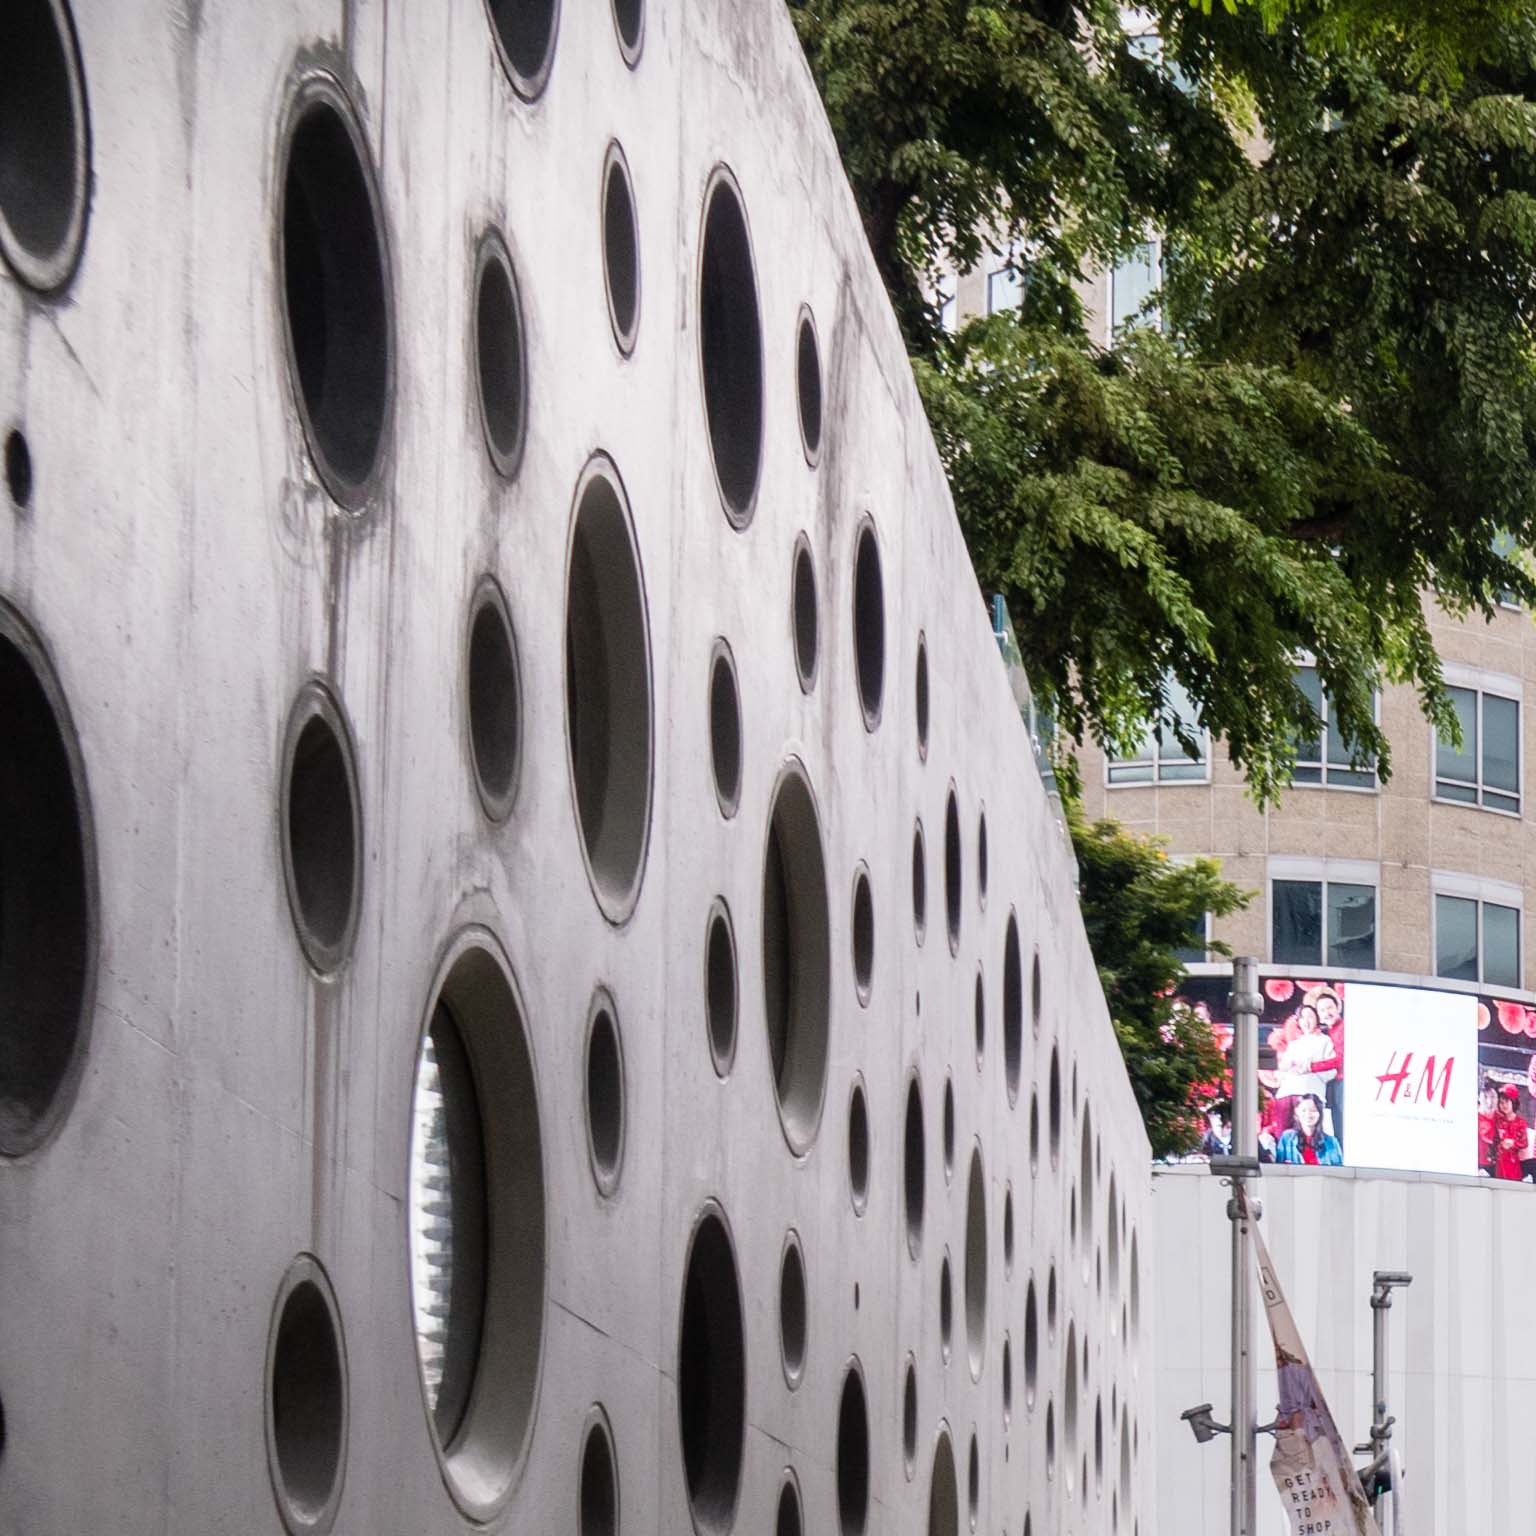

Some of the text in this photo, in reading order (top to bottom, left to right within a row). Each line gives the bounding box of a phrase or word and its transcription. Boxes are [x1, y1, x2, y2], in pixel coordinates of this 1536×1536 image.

[1374, 1051, 1454, 1109] H&M
[1284, 1472, 1313, 1489] GET
[1291, 1487, 1332, 1503] READY
[1296, 1507, 1312, 1519] TO
[1298, 1520, 1332, 1536] SHOP
